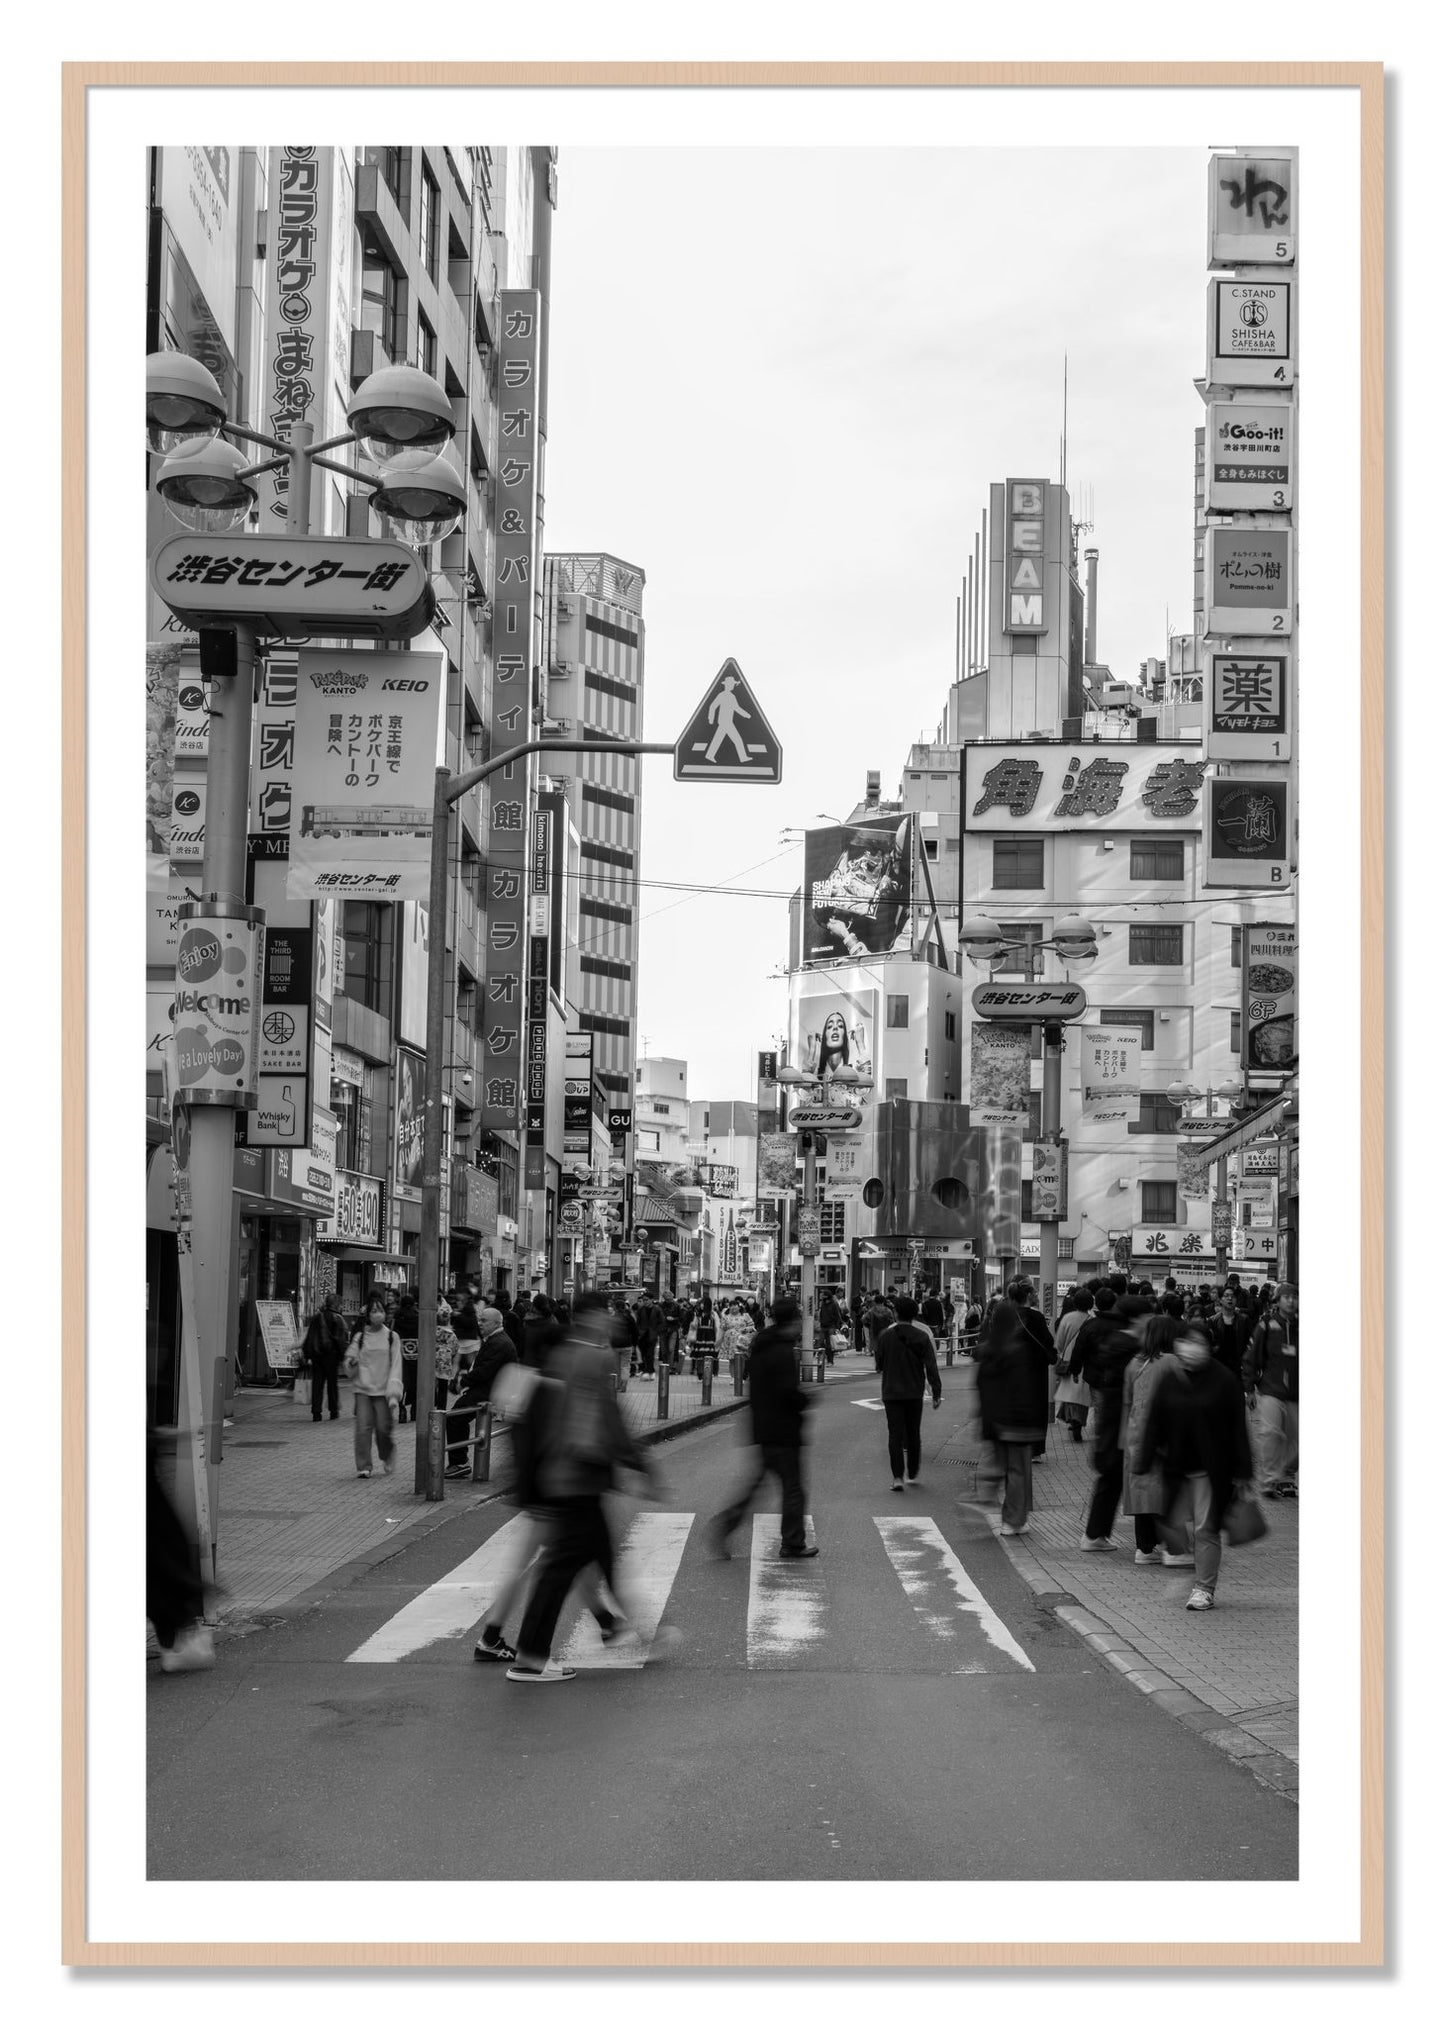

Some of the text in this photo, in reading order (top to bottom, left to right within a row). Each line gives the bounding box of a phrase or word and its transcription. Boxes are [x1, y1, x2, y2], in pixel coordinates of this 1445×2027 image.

[279, 158, 319, 295] カラオケ
[1276, 242, 1287, 257] 5
[1232, 288, 1276, 299] C.STAND
[1232, 328, 1275, 339] SHISHA
[1231, 339, 1276, 348] CAFE&BAR
[1274, 366, 1286, 381] 4
[1230, 424, 1283, 440] Goo-it!
[1223, 443, 1281, 453] 渋谷宇田川町店
[1219, 468, 1285, 480] 全身もみほぐし
[1273, 490, 1285, 507] 3
[1010, 484, 1043, 625] BEAM
[166, 554, 411, 591] 渋谷センター街
[1272, 615, 1284, 631] 2
[322, 687, 357, 695] KANTO
[381, 679, 430, 693] KEIO
[1223, 663, 1272, 713] 薬
[327, 714, 343, 756] 冒険へ
[345, 714, 362, 787] カントーの
[386, 715, 403, 773] 京王線で
[1272, 741, 1280, 756] 1
[972, 757, 1205, 817] 角海老
[538, 815, 546, 850] kimono
[315, 873, 401, 886] 渋谷センター街
[1271, 866, 1282, 882] B
[179, 941, 219, 975] Enjoy
[176, 989, 250, 1016] Welcome
[979, 992, 1080, 1005] 渋谷センター街
[1250, 1001, 1277, 1020] 6F
[192, 1047, 221, 1065] Lovely
[223, 1045, 243, 1062] Day!
[257, 1121, 277, 1129] Bank
[258, 1112, 291, 1123] Whisky
[610, 1115, 631, 1126] GU
